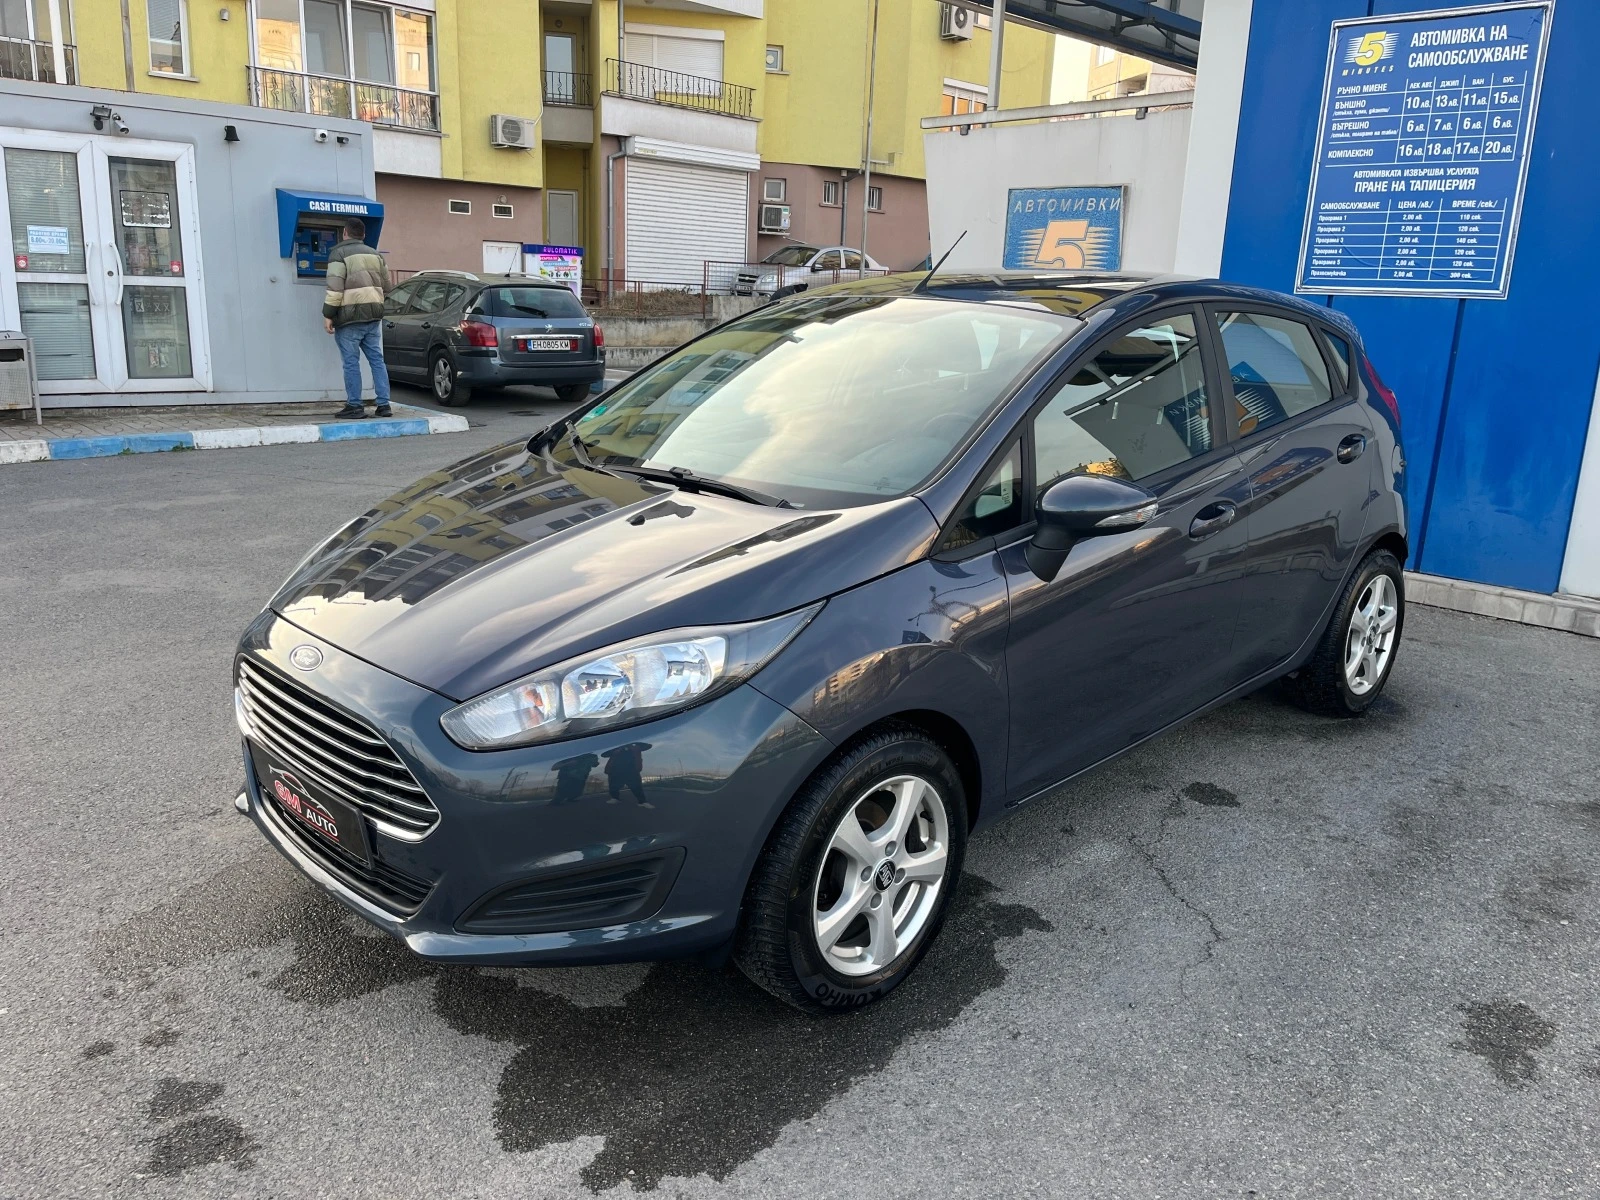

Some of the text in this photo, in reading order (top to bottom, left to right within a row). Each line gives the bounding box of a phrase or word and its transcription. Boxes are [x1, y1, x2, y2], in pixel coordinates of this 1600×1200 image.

[1411, 25, 1508, 47] АВТОМИВКА НА
[1354, 31, 1387, 66] 5
[1408, 44, 1528, 68] САМООБСЛУЖВАНЕ
[1342, 66, 1394, 76] MINUTES
[1337, 83, 1387, 95] РЪЧНО МИЕНЕ
[1406, 96, 1420, 108] 10
[1435, 95, 1448, 107] 13
[1494, 92, 1508, 104] 15
[1335, 100, 1366, 109] ВЪНШНО
[1332, 121, 1369, 131] ВЪТРЕШНО
[1407, 120, 1414, 132] 6
[1435, 119, 1442, 131] 7
[1464, 118, 1471, 130] 6
[1493, 116, 1501, 128] 6
[1328, 149, 1373, 158] КОМПЛЕКСНО
[1399, 144, 1413, 156] 16
[1427, 143, 1441, 155] 18
[1485, 142, 1500, 154] 20
[1354, 167, 1479, 179] АВТОМИВКАТА ИЗВЪРШВА УСЛУГАТА
[1354, 179, 1476, 193] ПРАНЕ НА ТАПИЦЕРИЯ
[310, 201, 368, 214] CASH TERMINAL
[1014, 197, 1121, 213] АВТОМИВКИ
[1398, 201, 1416, 209] ЦЕНА
[1452, 200, 1476, 208] ВРЕМЕ
[1035, 219, 1089, 269] 5
[275, 780, 338, 836] GM AUTO
[815, 982, 892, 1005] KUMHO
